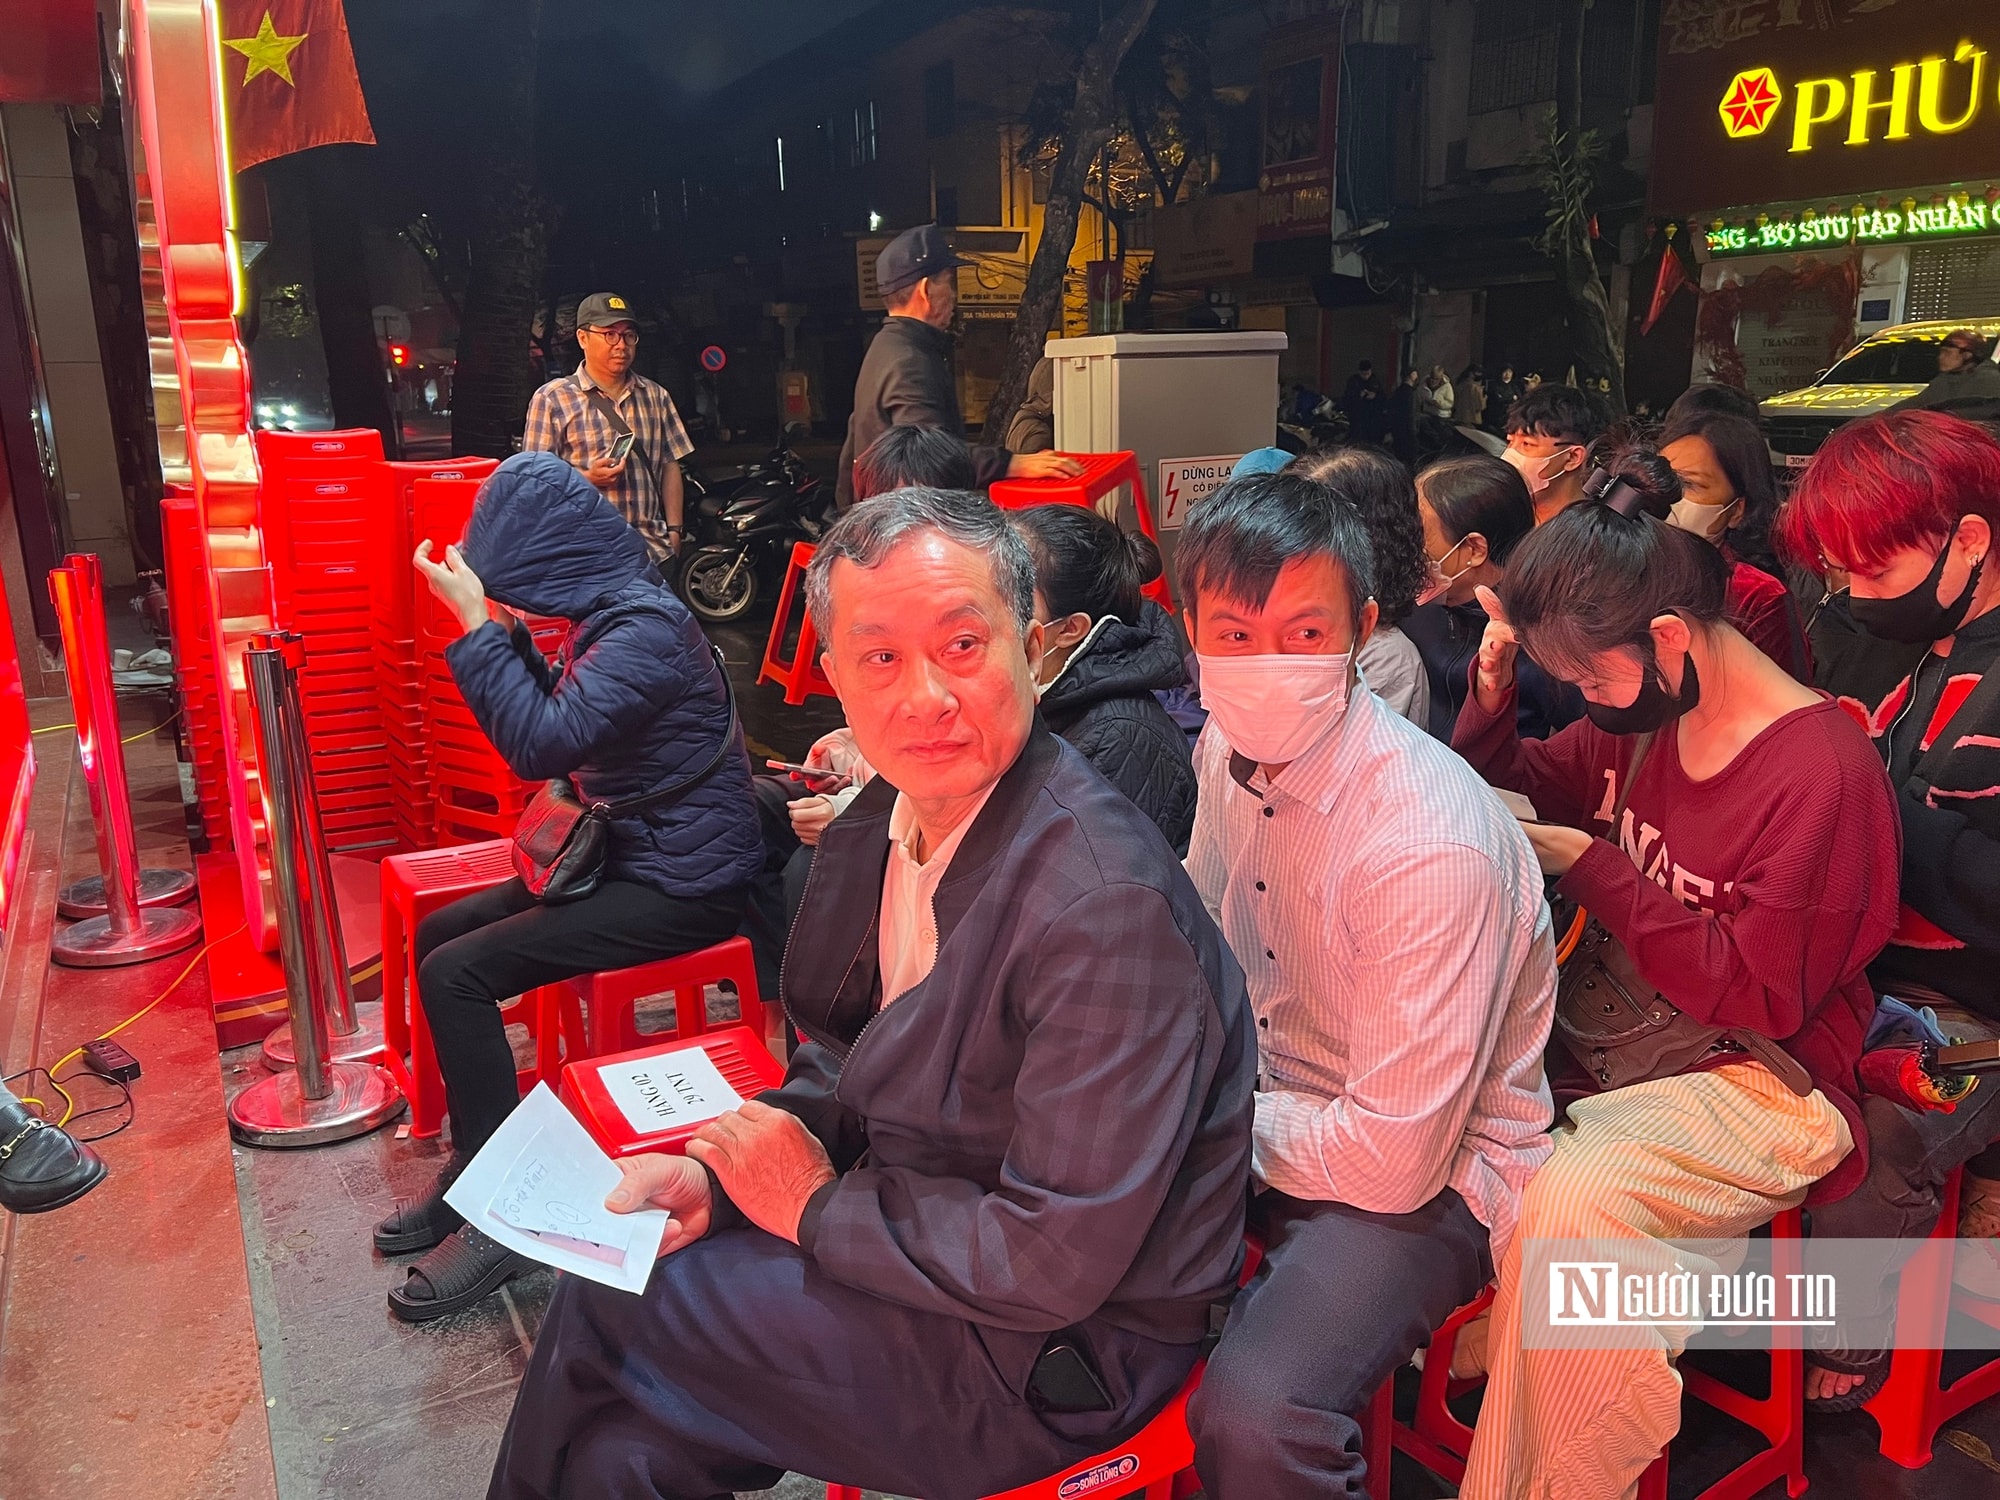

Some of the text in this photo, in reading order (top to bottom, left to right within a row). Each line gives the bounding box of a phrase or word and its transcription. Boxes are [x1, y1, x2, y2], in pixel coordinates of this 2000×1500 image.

[1788, 44, 1987, 152] PHÚ
[1853, 210, 1902, 238] TẬP
[1182, 465, 1234, 480] DỪNG LẠ
[1193, 482, 1205, 492] CÓ
[631, 1073, 677, 1117] HÀNG 02
[665, 1073, 705, 1105] 29 TNT
[1080, 1475, 1100, 1490] SONG
[1100, 1466, 1119, 1483] LONG
